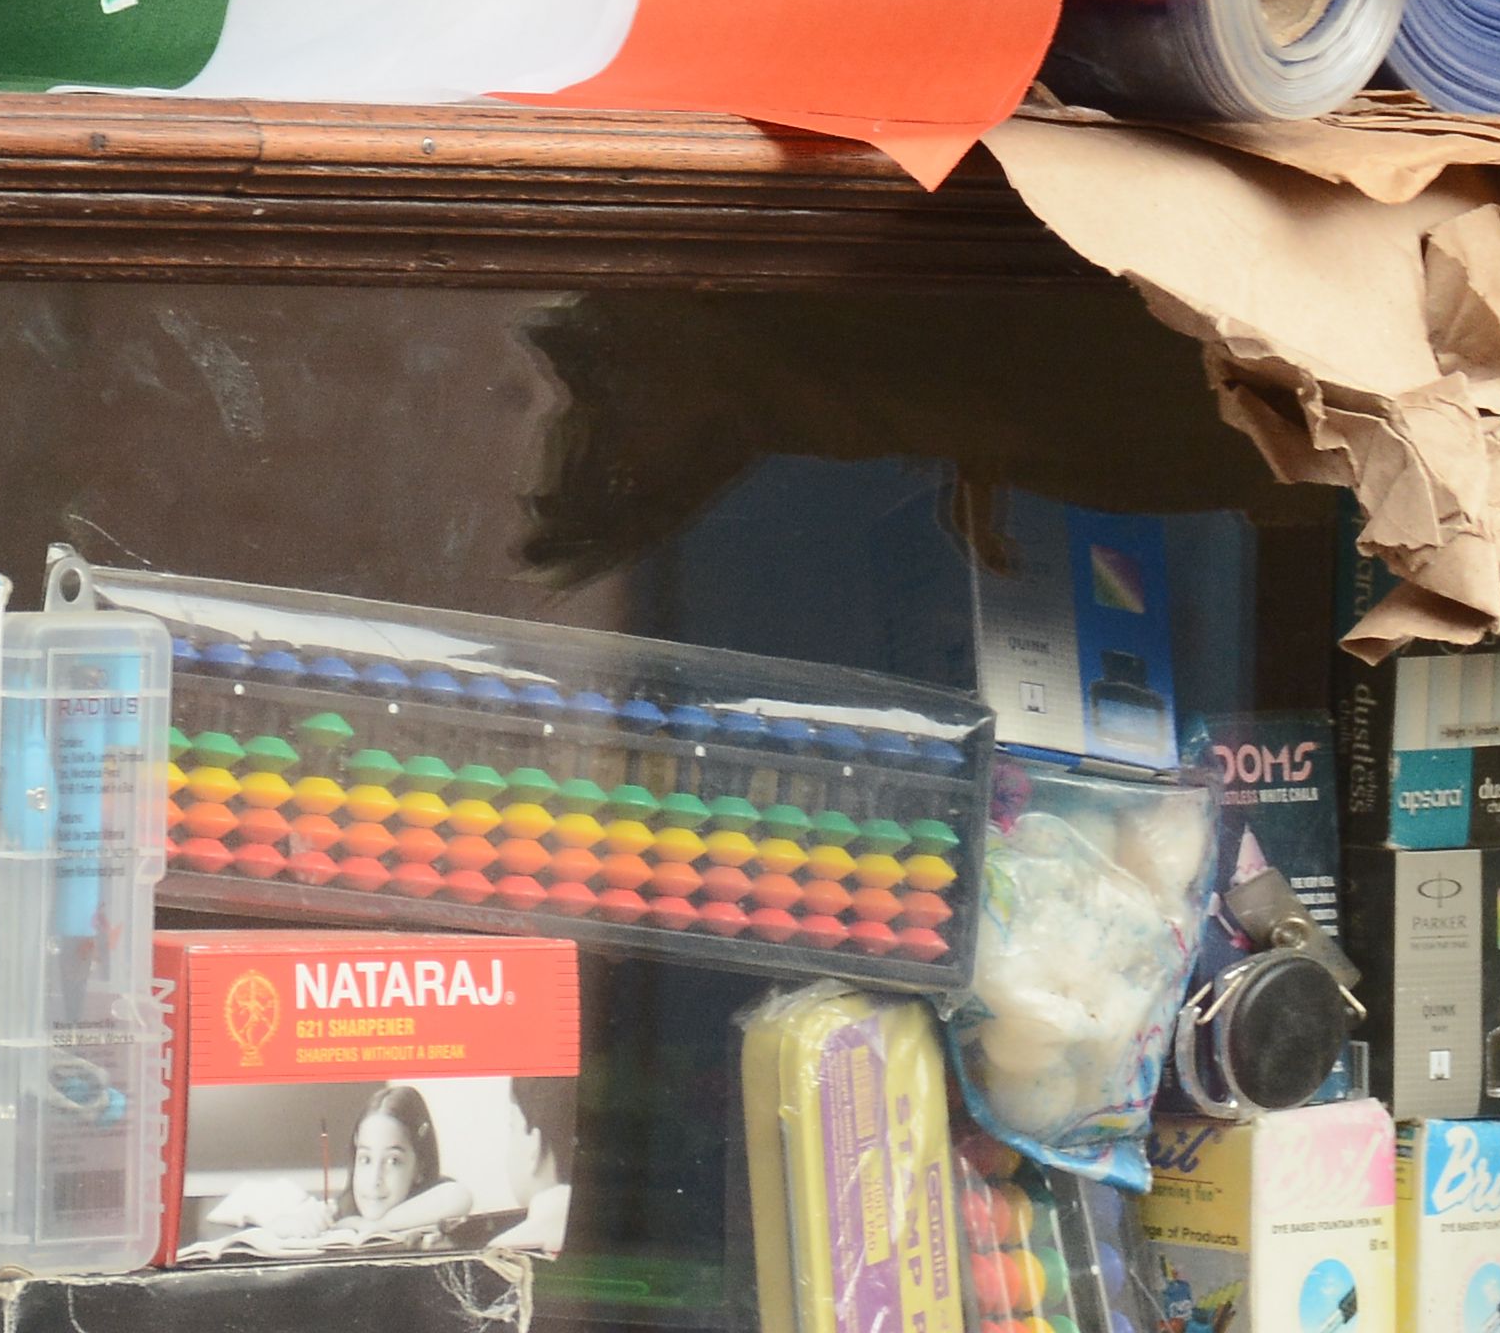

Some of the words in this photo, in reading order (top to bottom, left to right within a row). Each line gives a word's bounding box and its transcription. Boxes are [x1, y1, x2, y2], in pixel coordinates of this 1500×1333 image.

[57, 697, 140, 717] RADIUS
[1398, 786, 1463, 816] apsara
[1411, 915, 1467, 930] PARKER
[294, 959, 504, 1011] NATARAJ
[295, 1018, 325, 1040] 621
[327, 1016, 417, 1038] SHARPENER
[294, 1045, 360, 1064] SHARPENS
[361, 1044, 415, 1062] WITHOUT
[426, 1042, 467, 1061] BREAK
